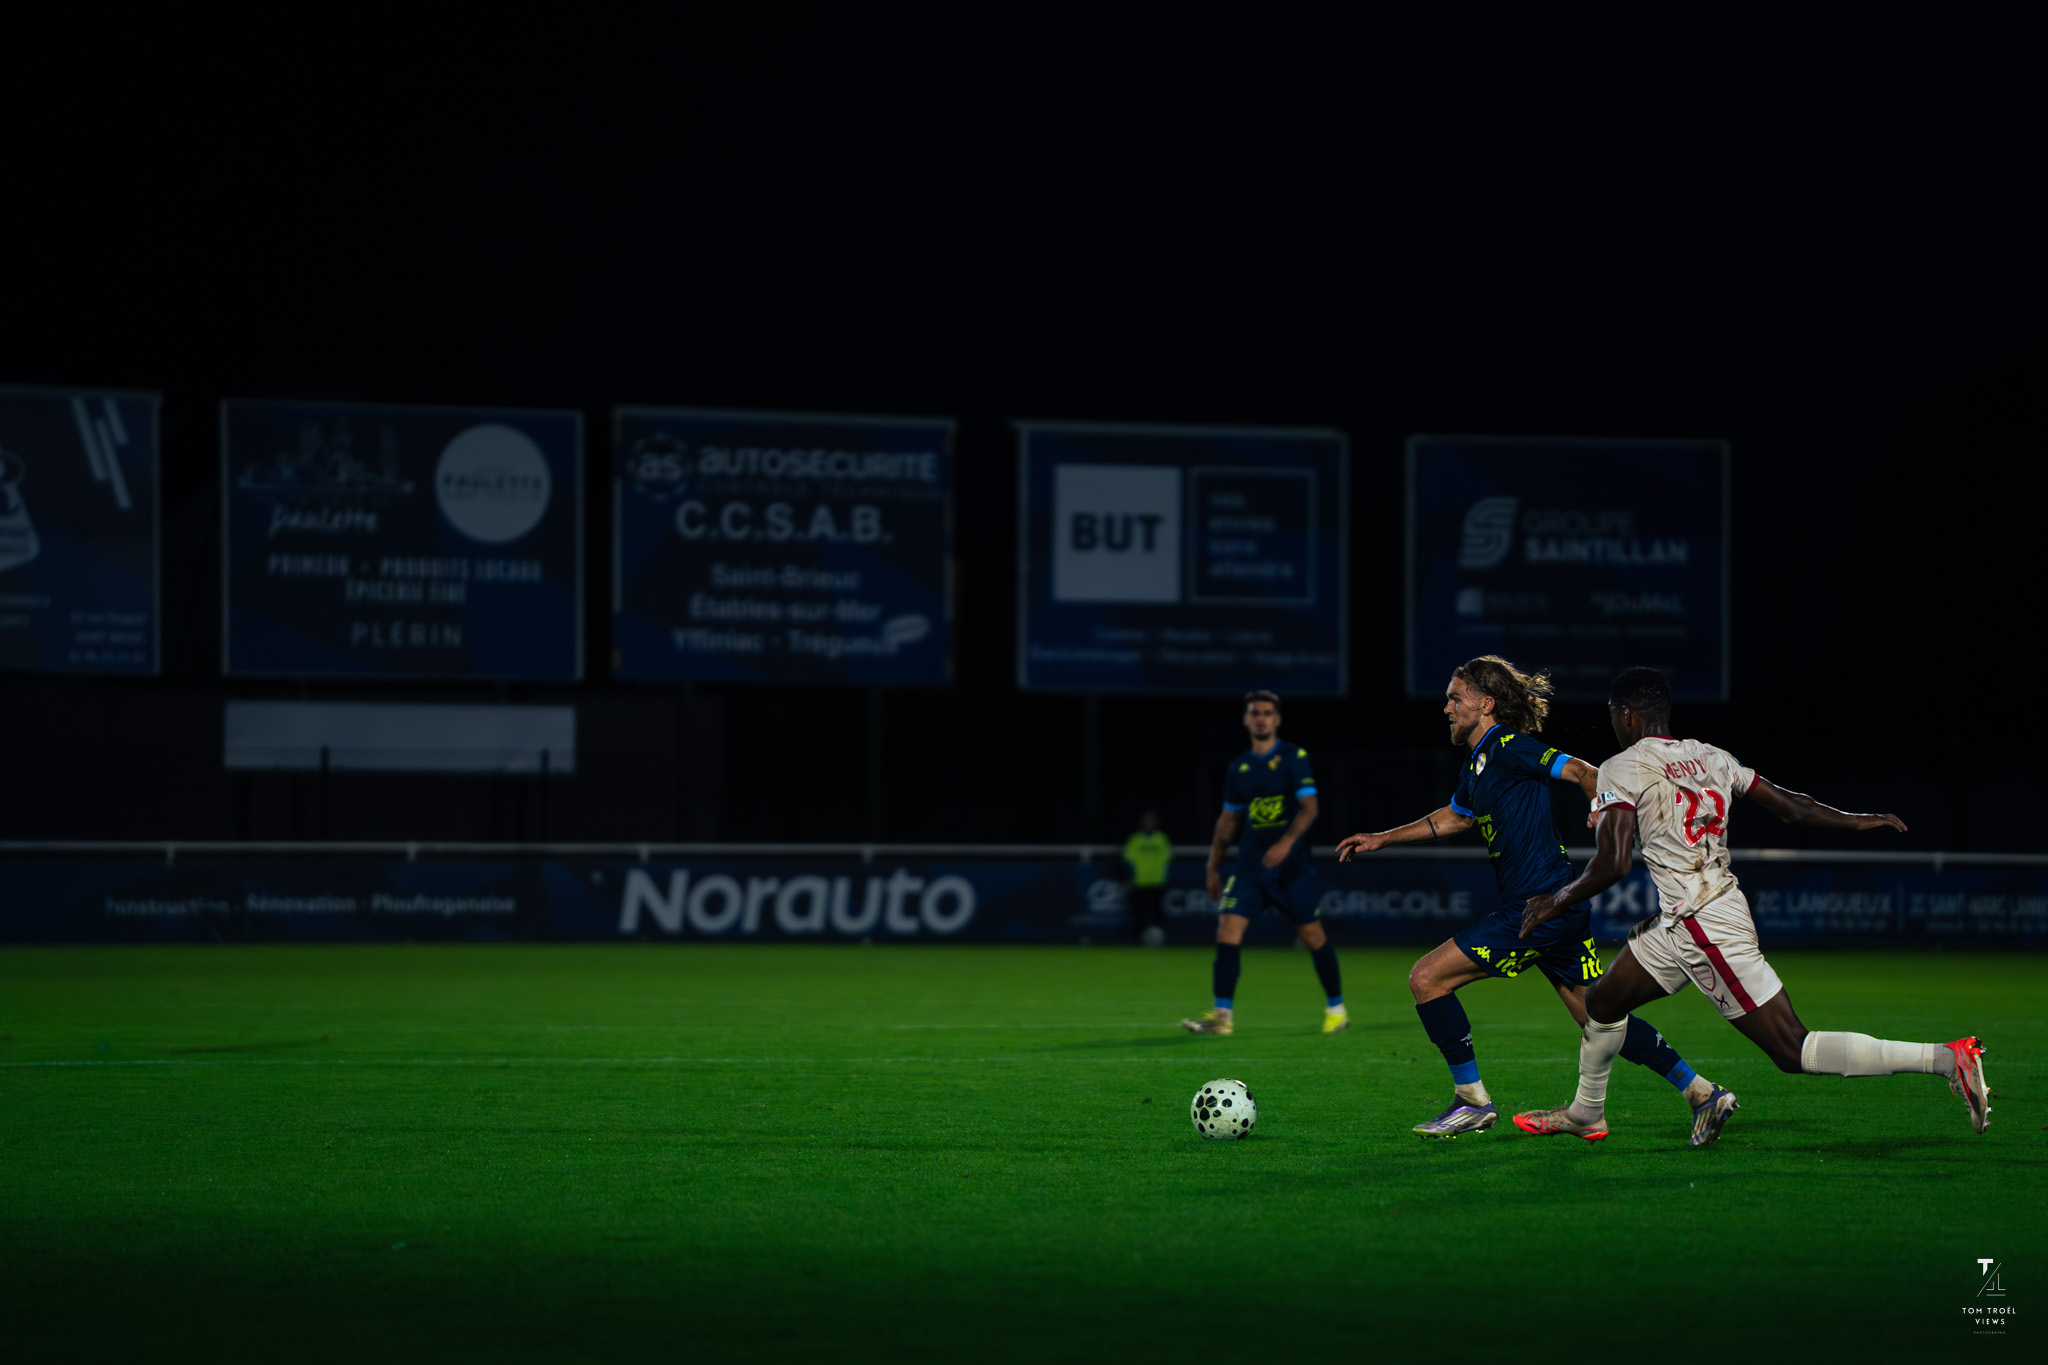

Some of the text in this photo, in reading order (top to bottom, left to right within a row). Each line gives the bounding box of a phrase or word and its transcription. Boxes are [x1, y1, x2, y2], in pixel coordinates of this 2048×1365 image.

[675, 500, 897, 544] C.C.S.A.B.
[1071, 513, 1164, 553] BUT
[1661, 756, 1707, 780] MENDY
[1675, 788, 1726, 848] 22
[618, 867, 979, 935] Norauto
[1319, 888, 1472, 918] GRICOLE
